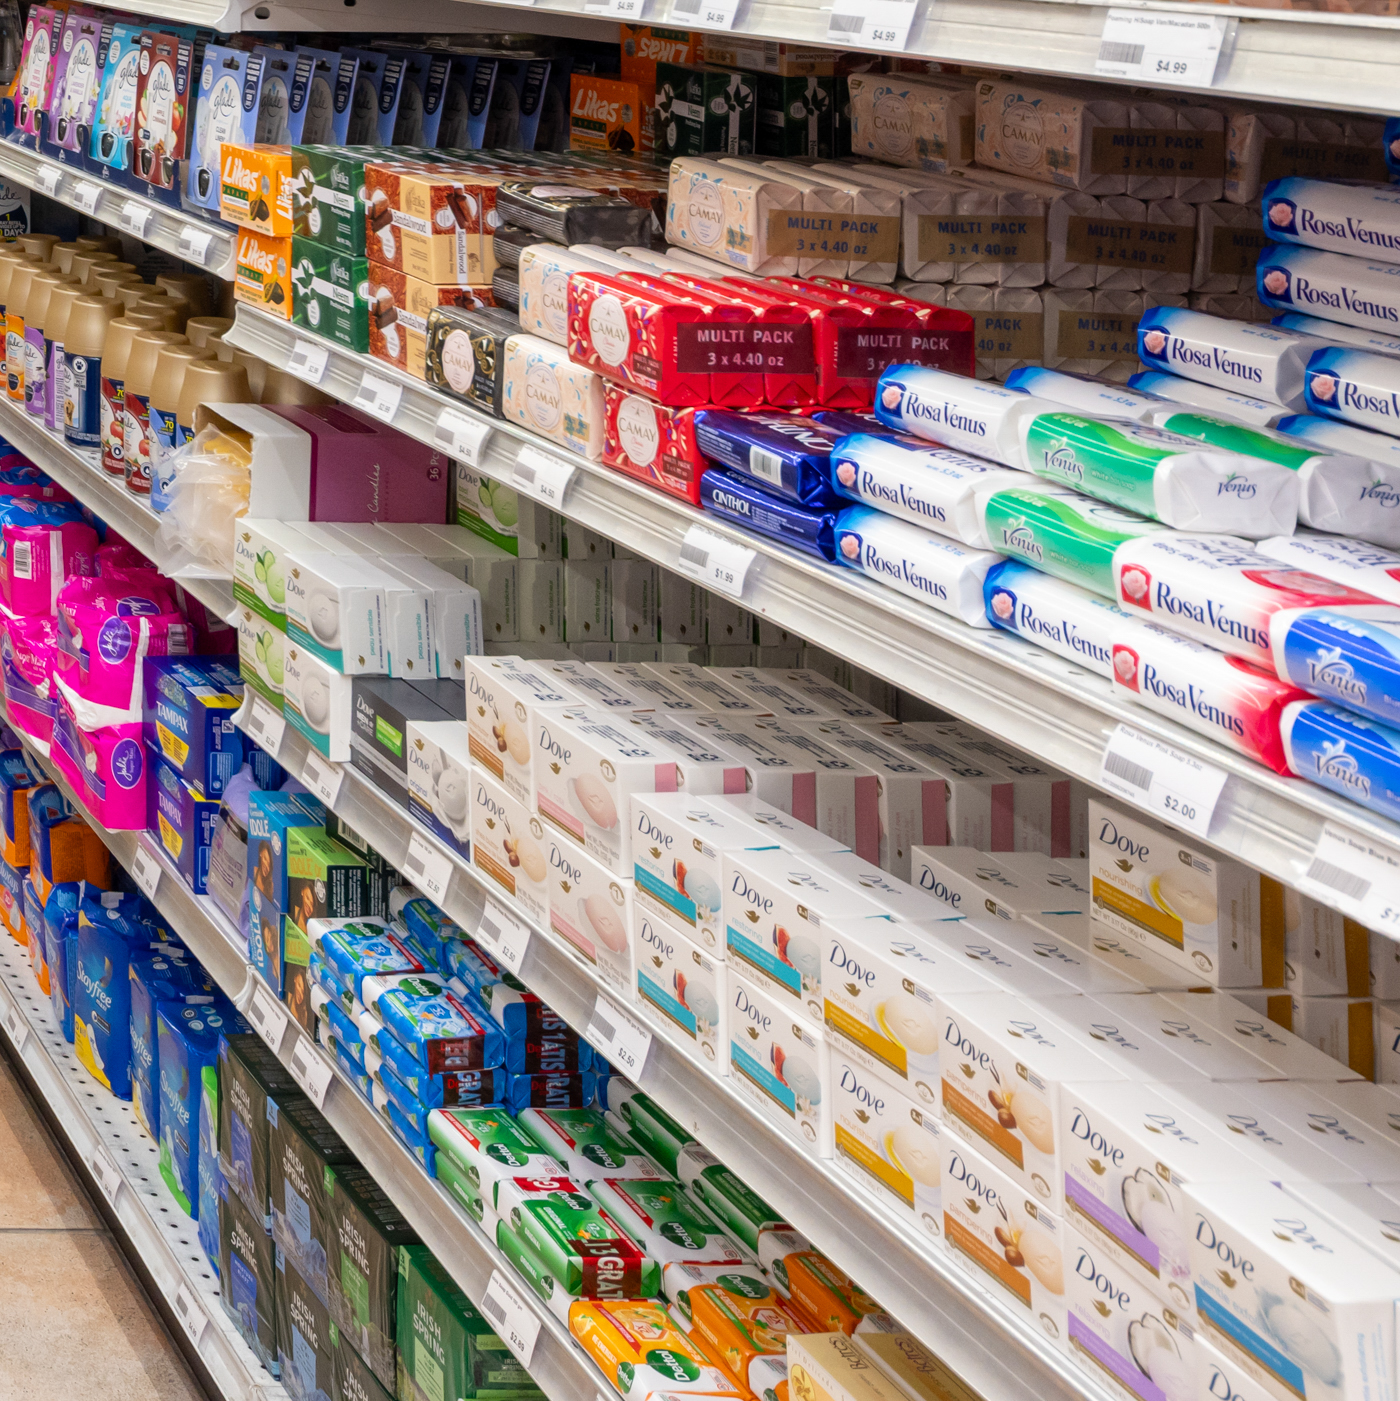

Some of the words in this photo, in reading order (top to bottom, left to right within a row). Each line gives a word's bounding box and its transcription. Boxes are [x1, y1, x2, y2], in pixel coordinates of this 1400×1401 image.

[707, 12, 724, 23] $4.99
[872, 30, 895, 41] $4.99
[1156, 60, 1187, 74] $4.99
[212, 92, 237, 116] glade
[223, 158, 258, 192] Likas
[4, 226, 25, 235] DAYS
[393, 212, 427, 234] Sandalwood
[787, 217, 823, 234] MULTI
[831, 219, 879, 235] PACK
[458, 230, 467, 273] Sandalwood
[591, 316, 627, 343] CAMAY
[697, 328, 745, 344] MULTI
[753, 328, 794, 344] PACK
[732, 352, 761, 368] 4.40
[768, 355, 784, 368] oz
[525, 382, 559, 409] CAMAY
[619, 417, 657, 442] CAMAY
[429, 448, 438, 466] Pcs
[1041, 446, 1085, 482] Venus
[429, 467, 438, 480] 36
[1216, 474, 1258, 500] Venus
[541, 485, 554, 498] $4.50
[712, 489, 751, 518] CINTHOL
[539, 725, 572, 765] Dove
[1165, 796, 1195, 819] $2.00
[1100, 817, 1149, 864] Dove
[732, 869, 773, 917] Dove
[829, 939, 876, 990] Dove
[945, 1015, 991, 1071] Dove
[617, 1046, 636, 1068] $2.50
[232, 1077, 251, 1104] IRISH
[230, 1089, 253, 1128] SPRING
[1072, 1106, 1125, 1169] Dove
[285, 1144, 306, 1173] IRISH
[283, 1157, 310, 1197] SPRING
[343, 1216, 367, 1248] IRISH
[339, 1231, 370, 1276] SPRING
[1195, 1211, 1254, 1281] Dove
